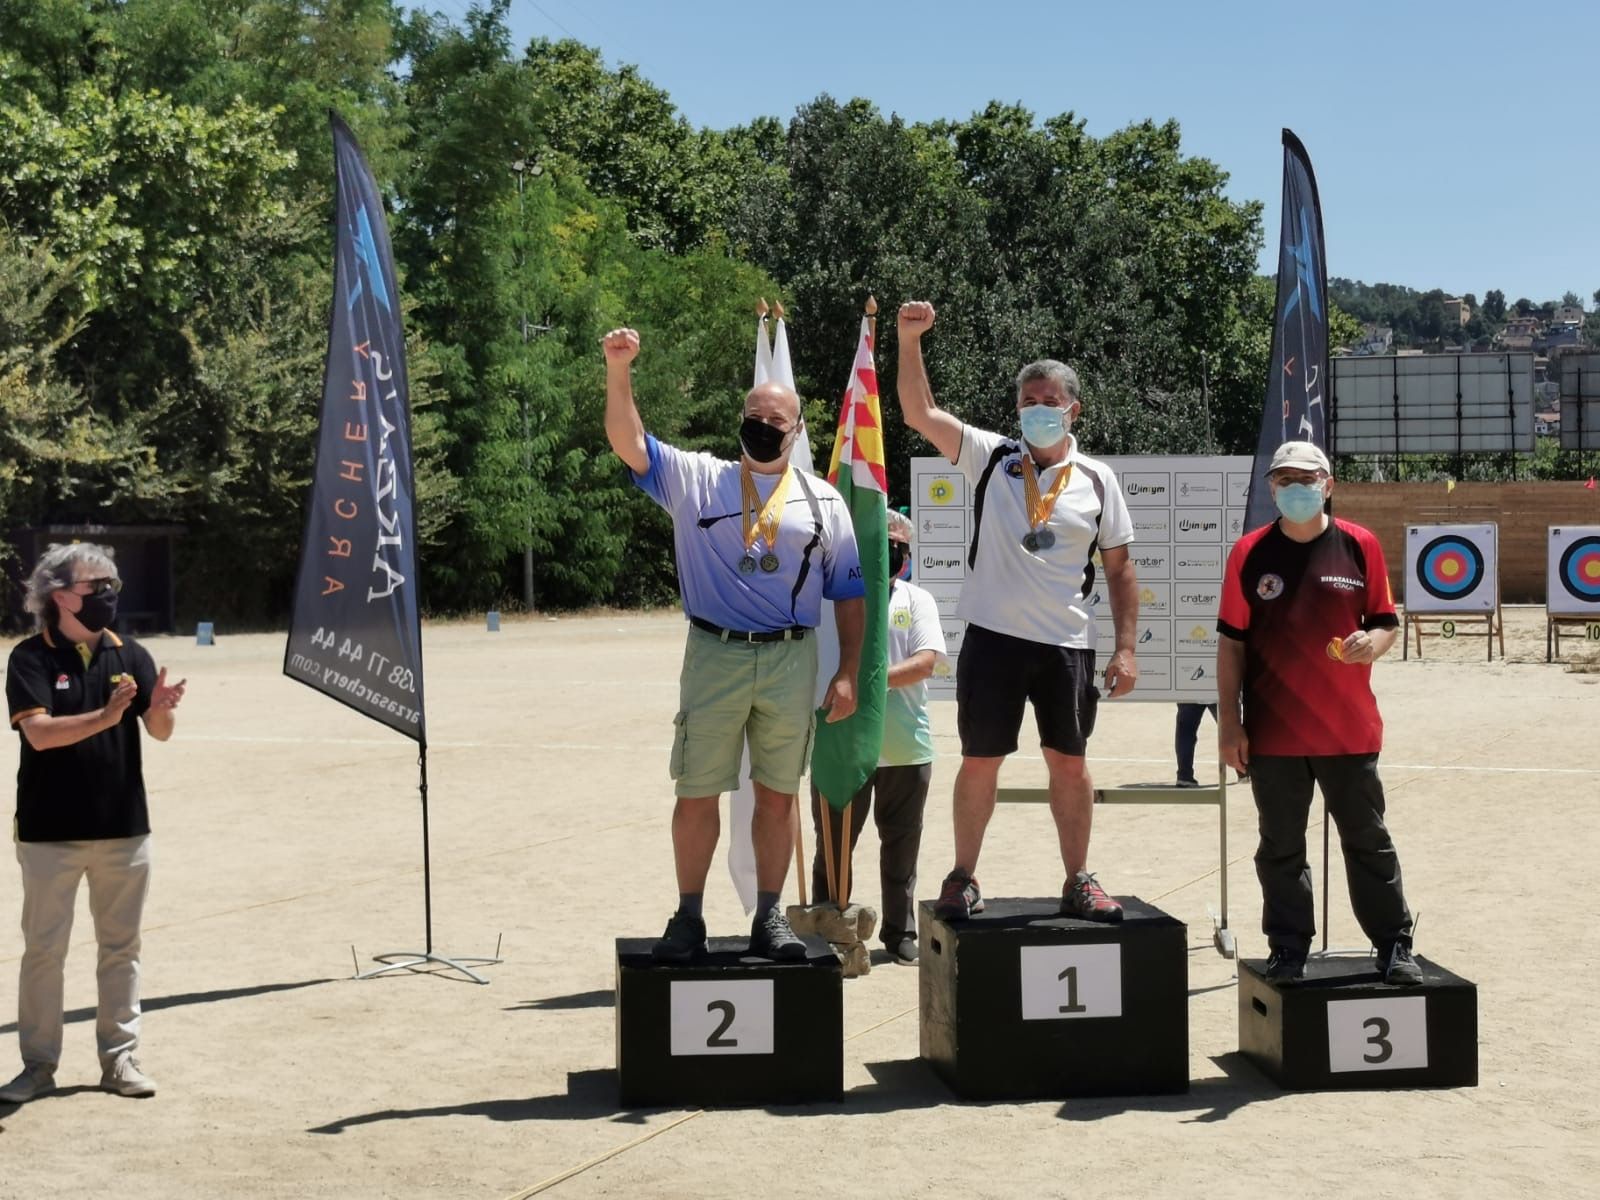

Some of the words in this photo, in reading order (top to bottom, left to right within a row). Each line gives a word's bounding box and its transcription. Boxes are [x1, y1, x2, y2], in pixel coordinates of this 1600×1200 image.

[1442, 621, 1455, 639] 9
[1586, 625, 1600, 640] 10
[1056, 966, 1087, 1014] 1
[706, 1000, 738, 1048] 2
[1362, 1016, 1393, 1064] 3
